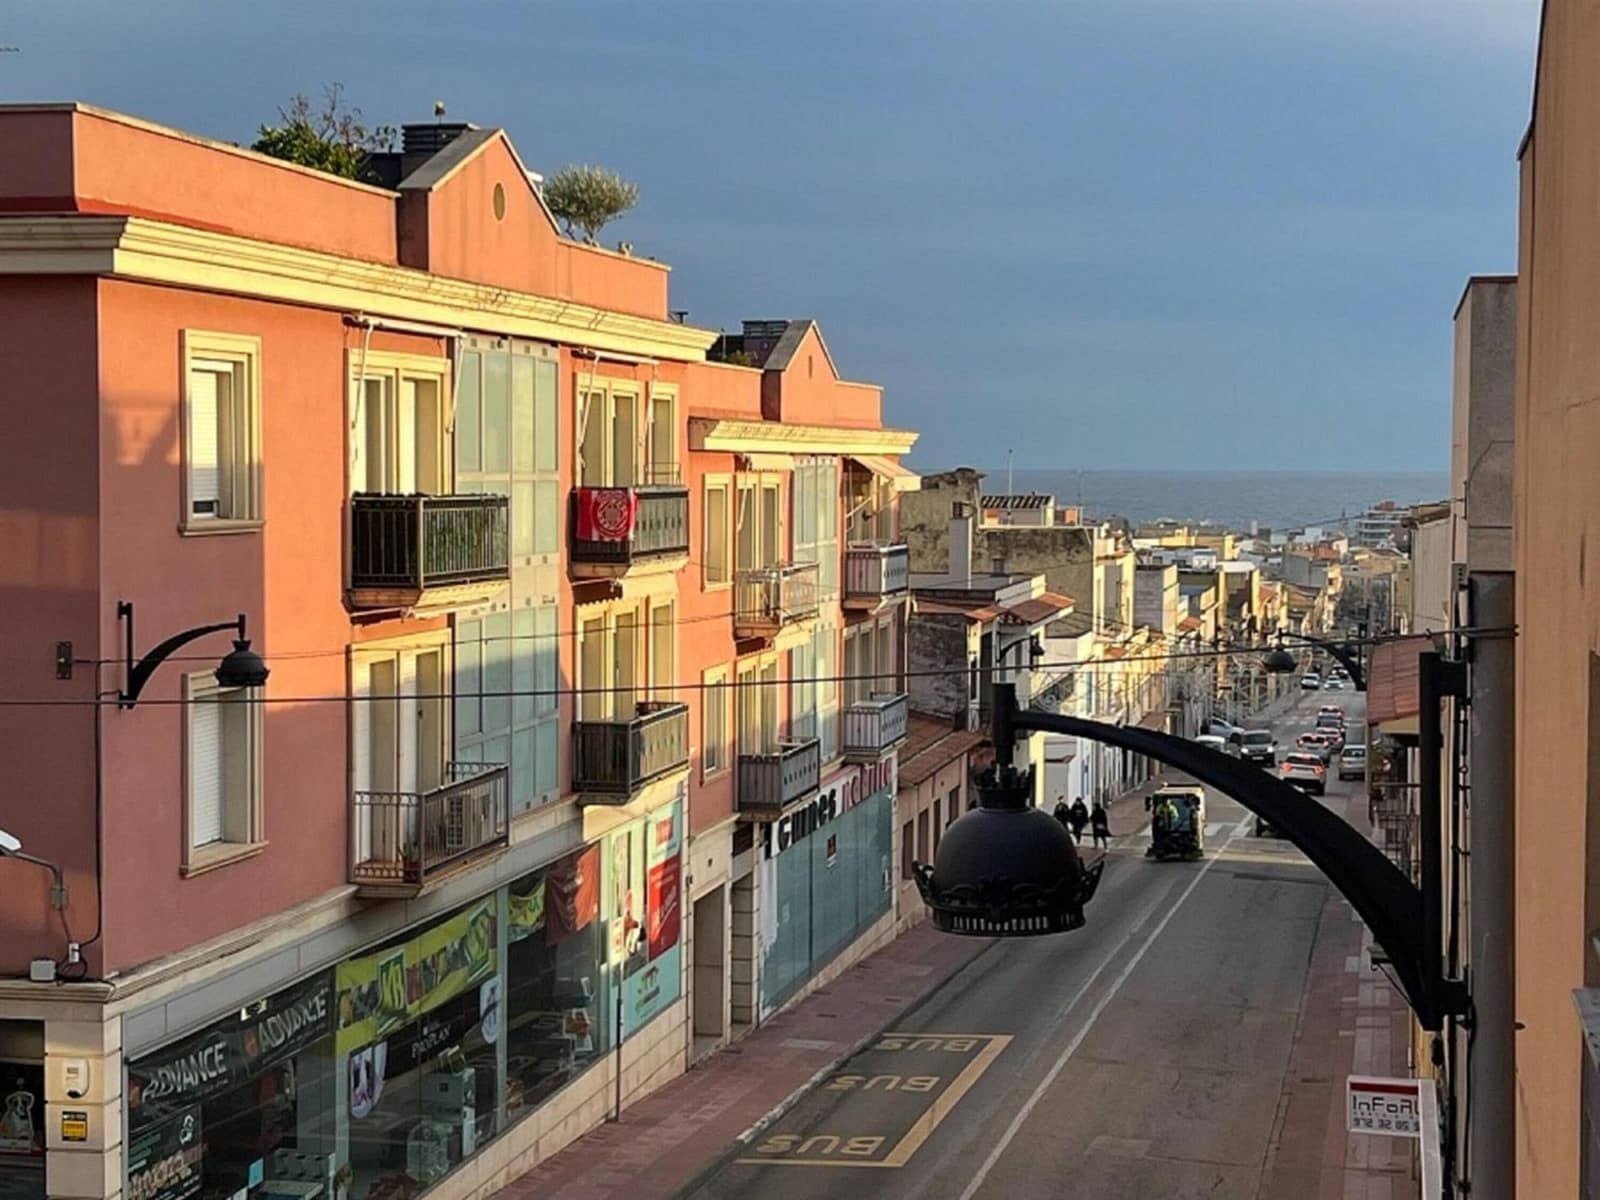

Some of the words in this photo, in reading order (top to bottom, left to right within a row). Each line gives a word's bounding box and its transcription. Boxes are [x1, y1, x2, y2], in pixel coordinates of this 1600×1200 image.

[257, 987, 329, 1053] ADVANCE
[874, 1039, 978, 1052] BUS
[141, 1042, 228, 1104] ADVANCE
[824, 1075, 940, 1092] BUS
[756, 1135, 885, 1155] BUS
